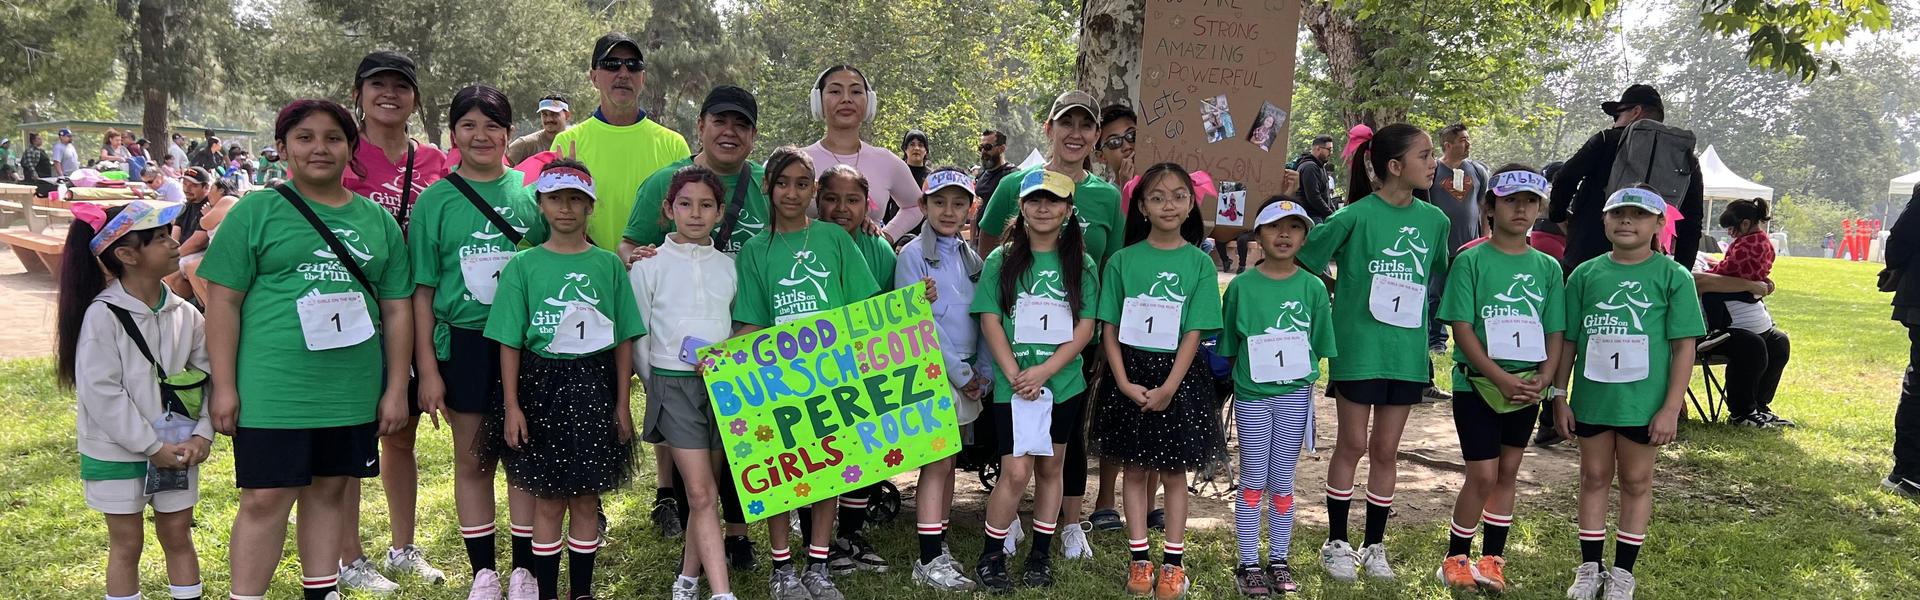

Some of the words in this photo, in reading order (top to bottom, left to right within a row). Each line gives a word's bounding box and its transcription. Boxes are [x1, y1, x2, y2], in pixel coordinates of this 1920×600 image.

[1193, 15, 1259, 40] STRONG
[1155, 37, 1244, 63] AMAZING
[1168, 61, 1263, 88] POWERFUL
[370, 191, 402, 207] Girl
[1368, 259, 1405, 273] Girls
[790, 301, 819, 314] run
[1392, 296, 1400, 313] 1
[1481, 305, 1519, 318] Girls
[331, 313, 342, 332] 1
[531, 310, 564, 326] Girl
[752, 319, 837, 367] GOOD
[842, 286, 921, 339] LUCK
[1040, 314, 1048, 331] 1
[1145, 316, 1153, 334] 1
[1583, 313, 1618, 328] Girls
[576, 321, 584, 340] 1
[1512, 331, 1521, 348] 1
[1597, 326, 1628, 335] run
[711, 345, 860, 417] BURSCH
[866, 319, 940, 371] GOTR
[1275, 350, 1284, 368] 1
[1610, 352, 1619, 370] 1
[772, 364, 935, 450] PEREZ
[856, 399, 942, 454] ROCK
